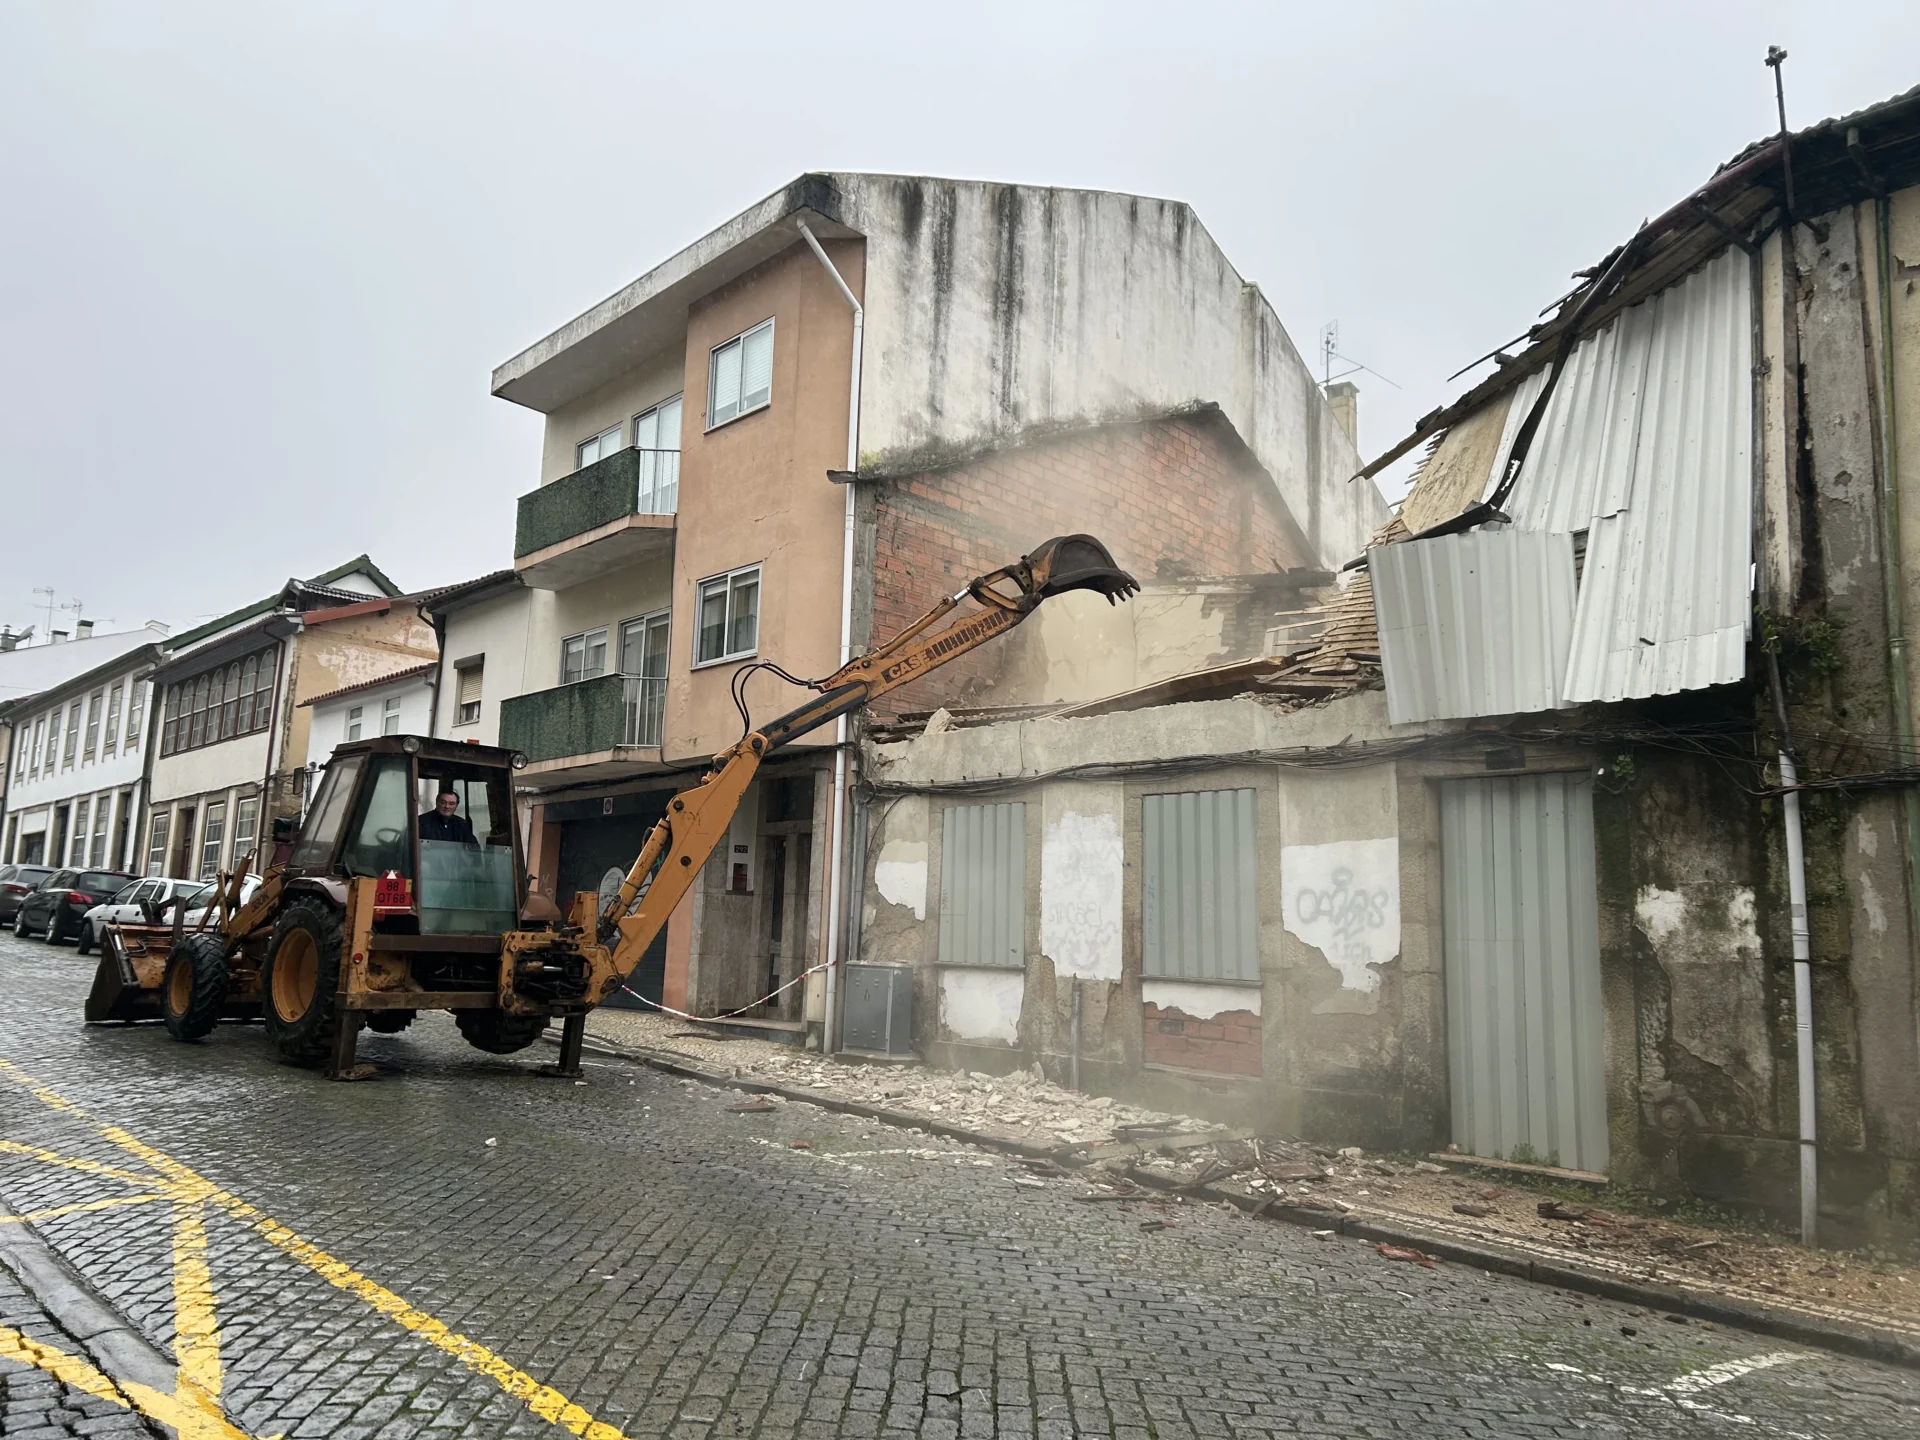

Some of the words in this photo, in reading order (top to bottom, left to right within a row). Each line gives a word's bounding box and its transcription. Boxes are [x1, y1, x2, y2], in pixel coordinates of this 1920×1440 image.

[889, 649, 932, 679] CASE
[735, 845, 748, 853] 292
[386, 881, 399, 891] 88
[377, 892, 405, 904] QT68
